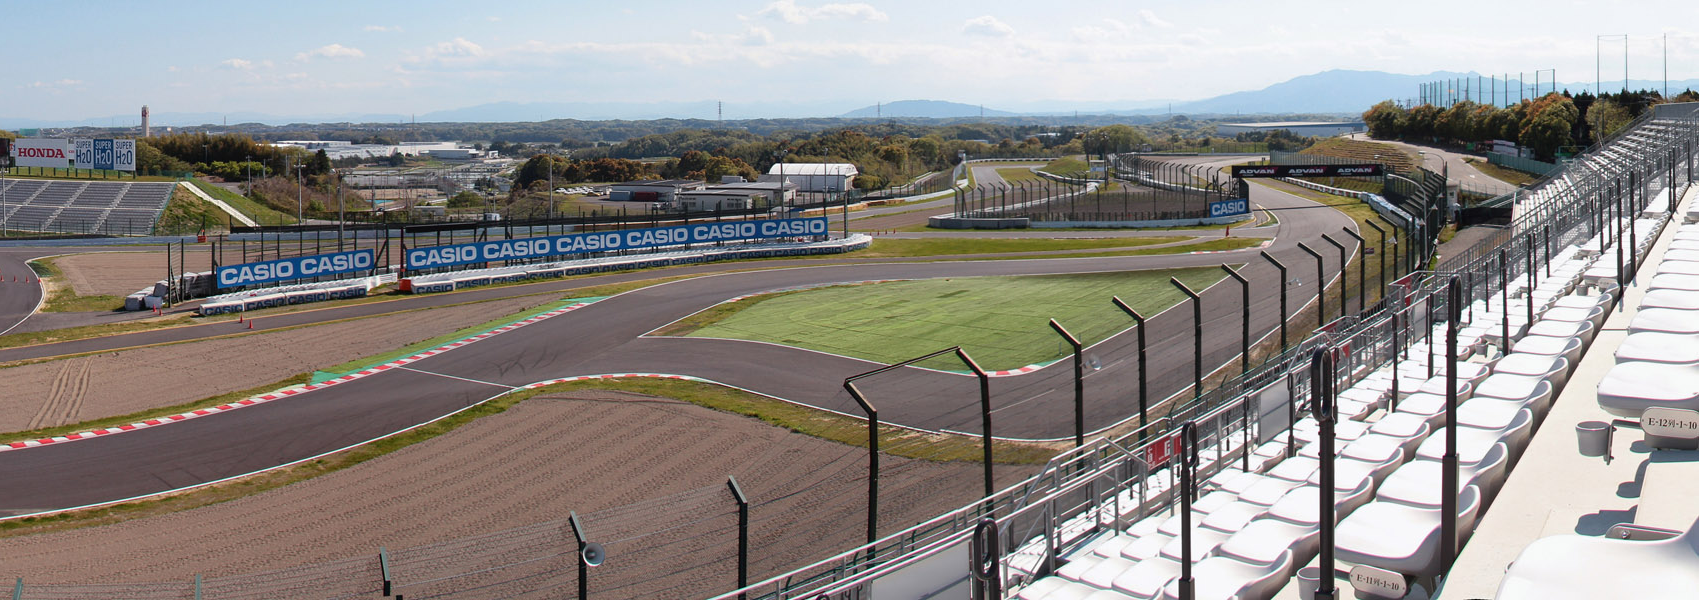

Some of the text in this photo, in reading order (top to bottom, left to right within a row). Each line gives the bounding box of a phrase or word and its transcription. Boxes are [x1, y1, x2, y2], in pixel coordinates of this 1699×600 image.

[76, 140, 92, 149] SUPER
[95, 140, 112, 150] SUPER
[115, 141, 133, 150] SUPER
[17, 147, 66, 159] HONDA
[1212, 201, 1246, 215] CASIO
[410, 219, 825, 267] CASIO CASIO CASIO CASIO CASIO CASIO
[220, 252, 371, 285] CASIO CASIO
[288, 293, 326, 305] CASIO
[330, 288, 366, 300] CASIO
[204, 304, 243, 316] CASIO
[246, 298, 285, 311] CASIO
